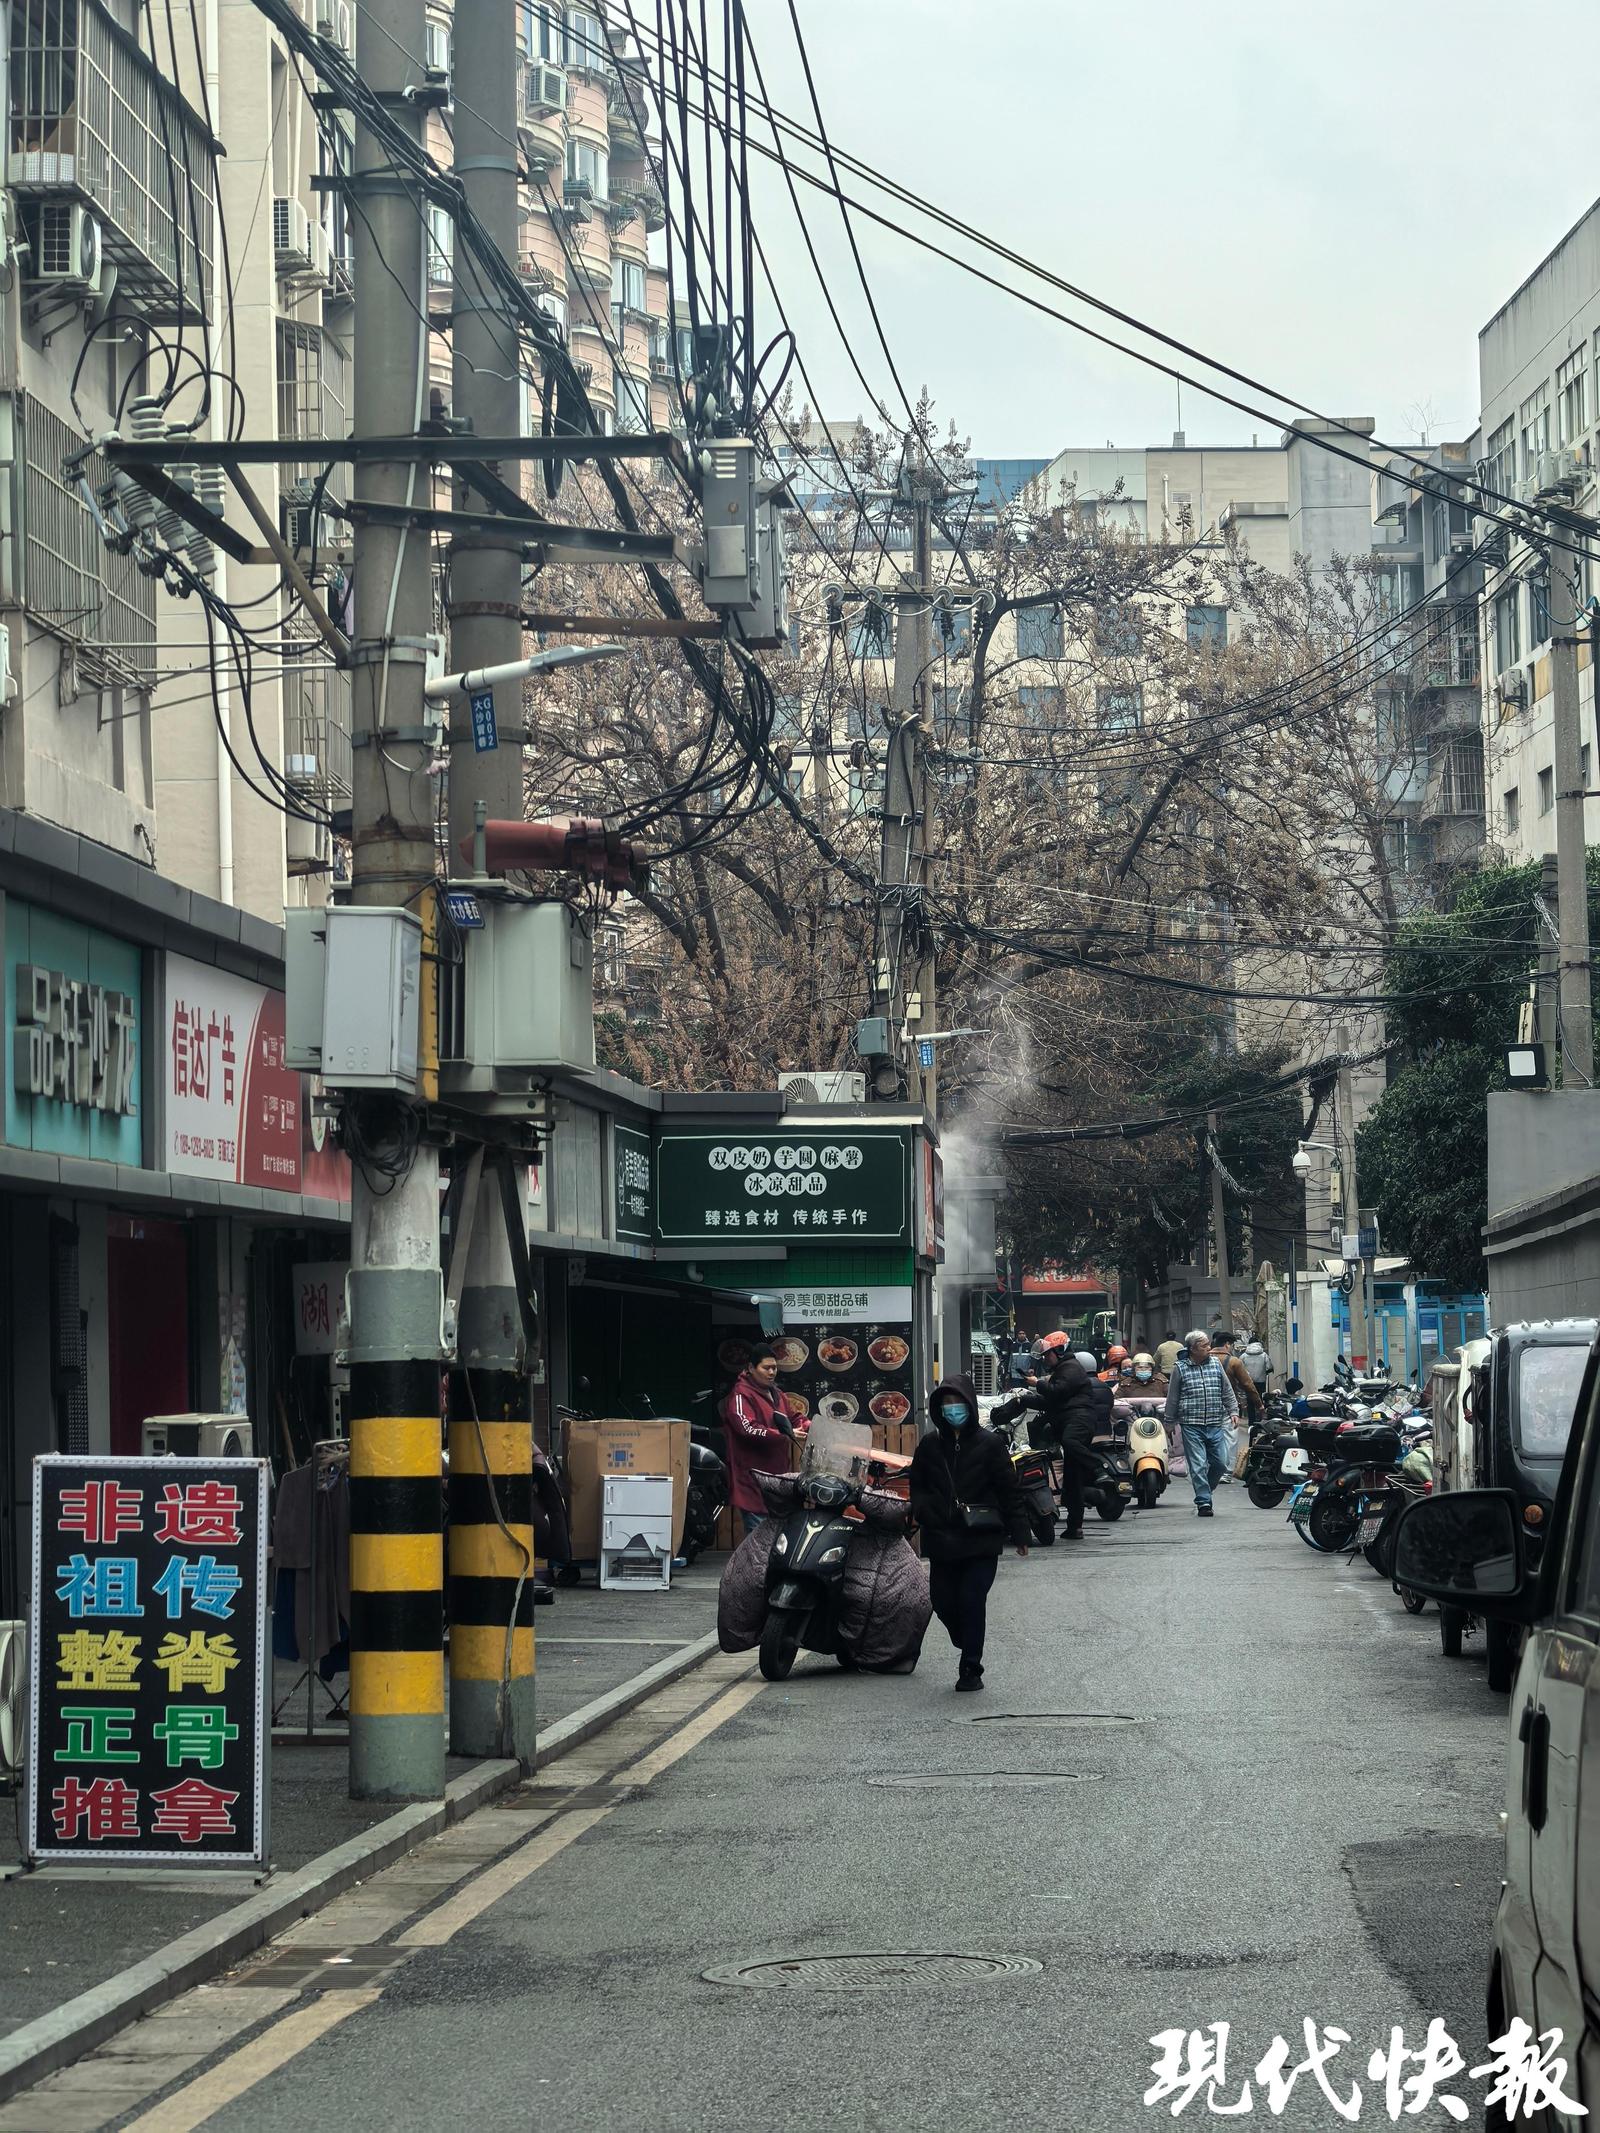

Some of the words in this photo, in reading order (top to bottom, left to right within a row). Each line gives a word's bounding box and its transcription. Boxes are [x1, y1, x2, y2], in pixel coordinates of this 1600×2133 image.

[483, 697, 494, 746] G002
[172, 1000, 236, 1107] 信达广告
[711, 1149, 769, 1168] 双皮奶
[777, 1148, 815, 1167] 芋圆
[822, 1148, 861, 1167] 麻薯
[747, 1175, 825, 1194] 冰凉甜品
[705, 1209, 779, 1226] 臻选食材
[792, 1209, 868, 1226] 传统手作
[783, 1293, 868, 1307] 易美圆甜品铺
[58, 1481, 244, 1545] 非遗
[55, 1554, 243, 1619] 祖传
[56, 1629, 241, 1693] 整脊
[53, 1705, 240, 1769] 正骨
[52, 1777, 240, 1843] 推拿
